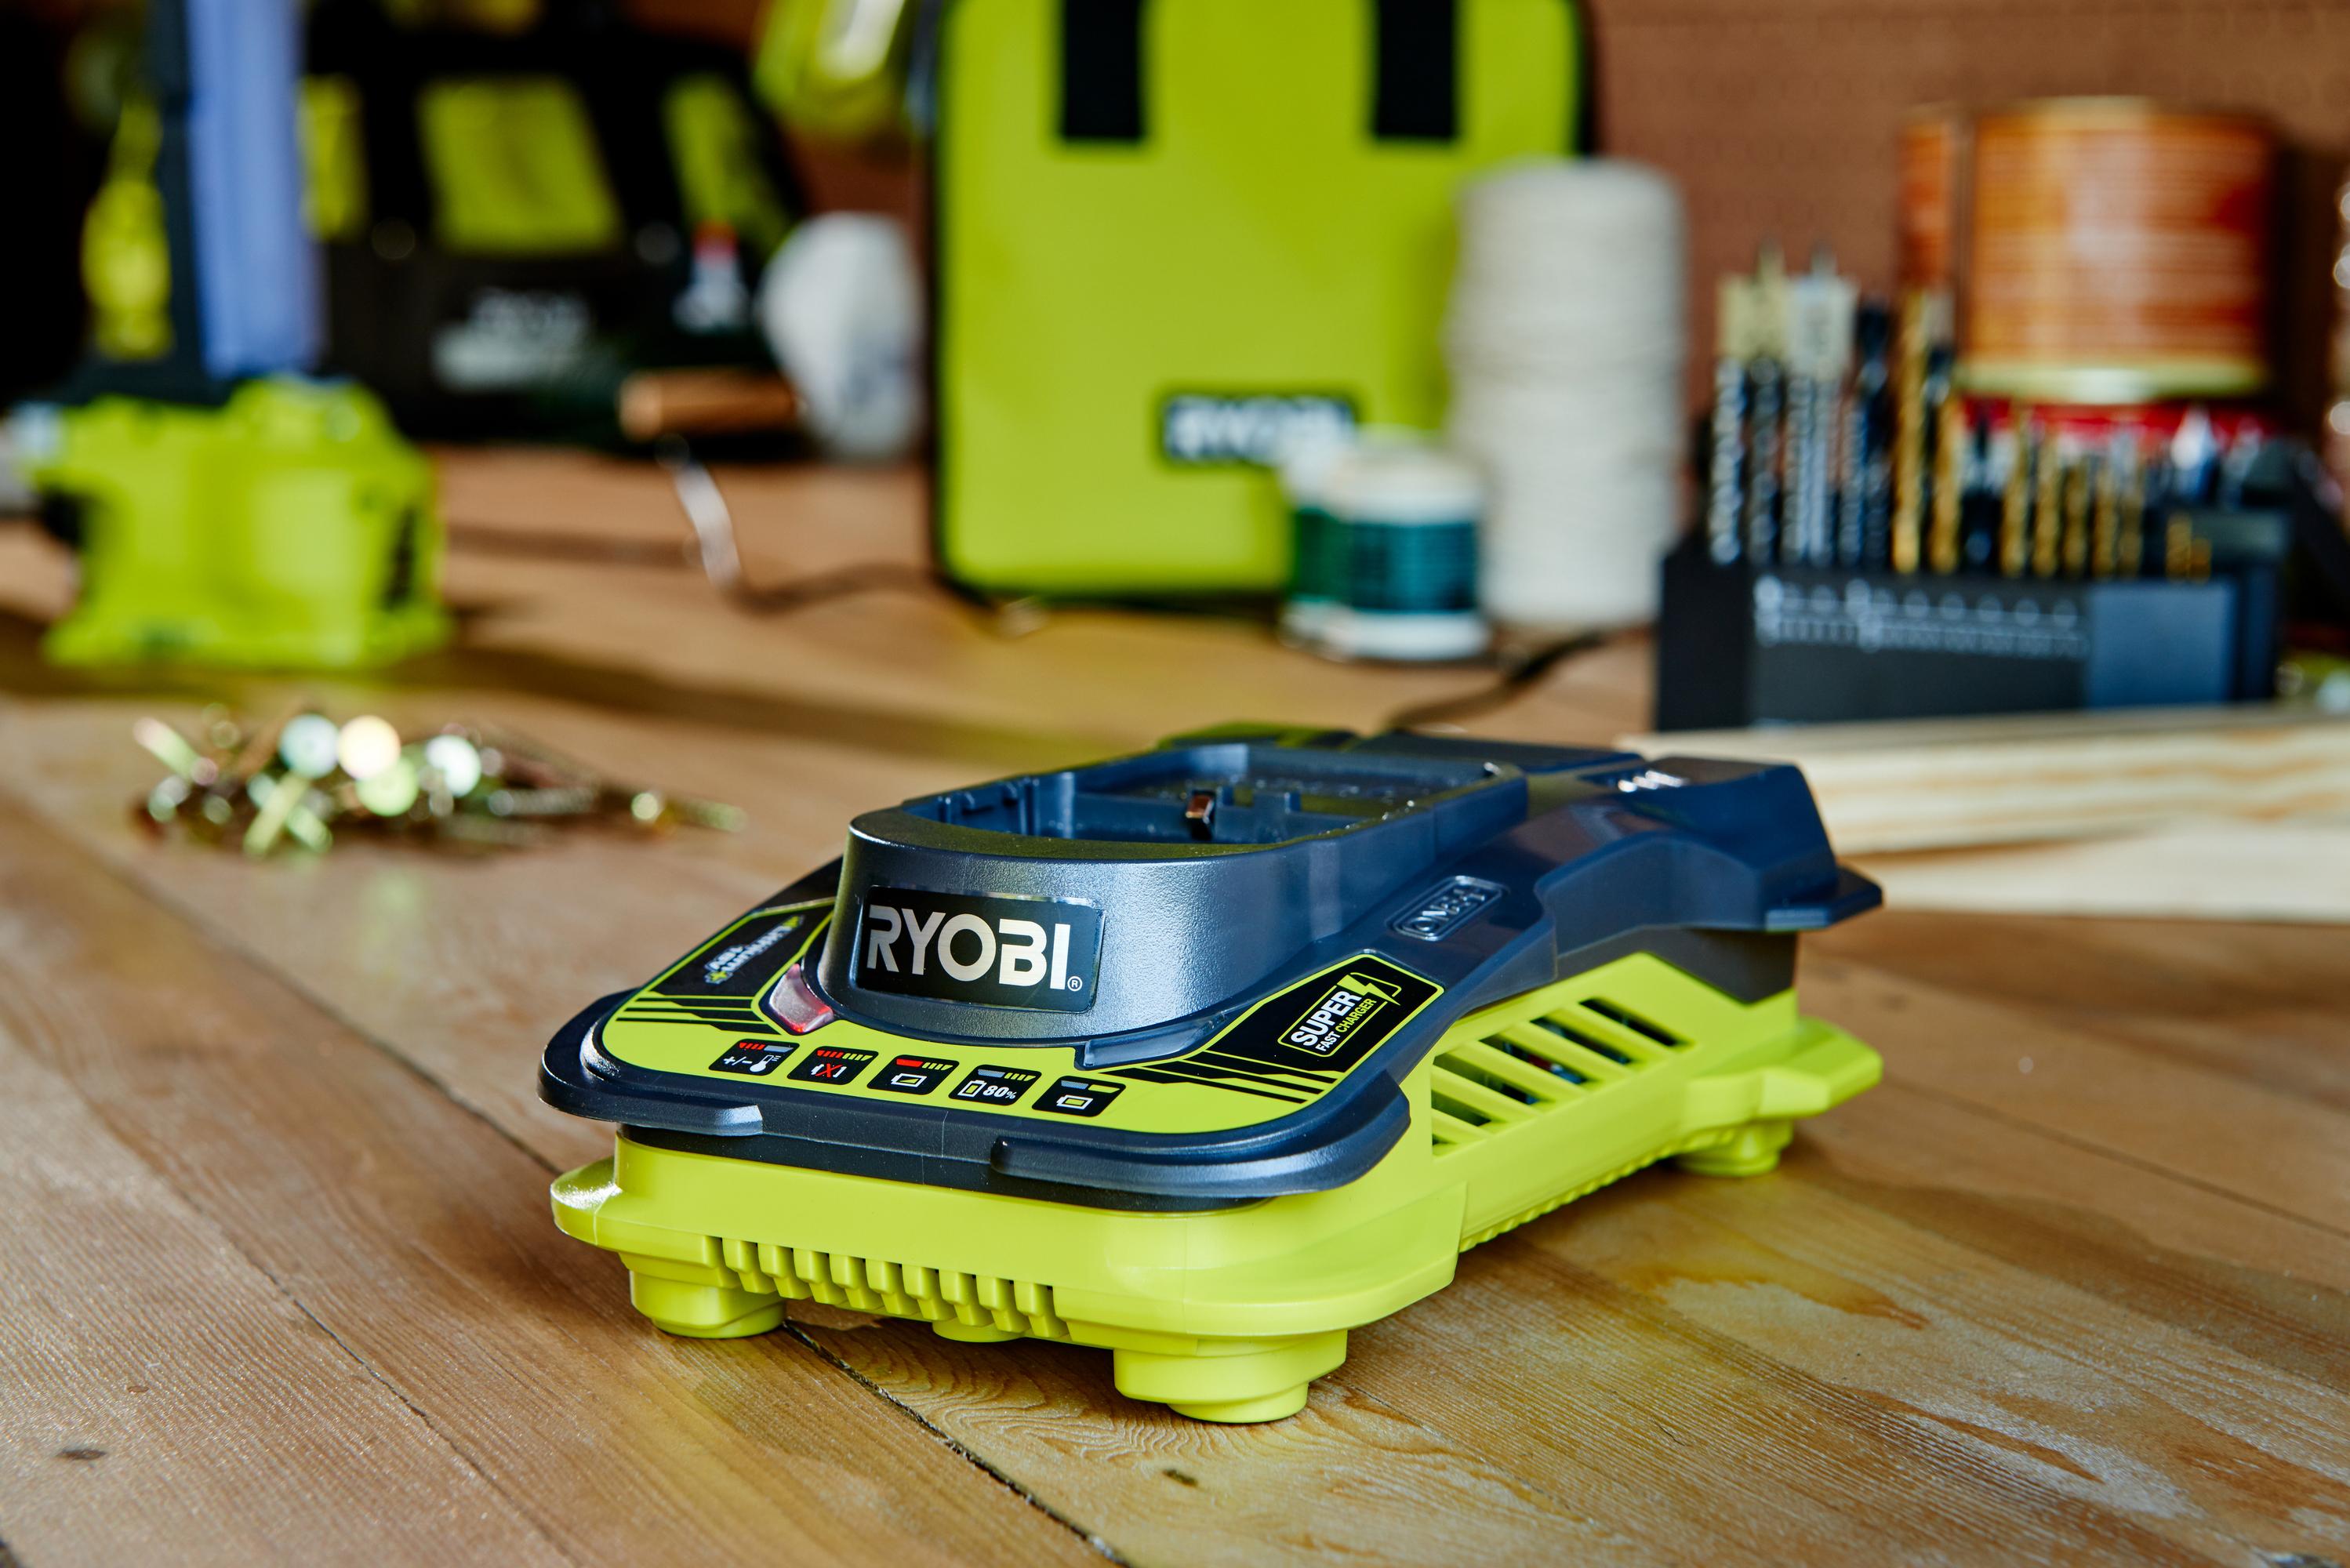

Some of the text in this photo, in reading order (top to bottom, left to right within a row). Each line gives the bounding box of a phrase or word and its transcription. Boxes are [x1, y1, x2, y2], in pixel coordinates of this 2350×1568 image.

[1170, 396, 1350, 461] RYO
[866, 904, 1071, 990] RYOBI
[1291, 990, 1362, 1047] SUPER
[1315, 997, 1377, 1051] FAST CHARGER
[982, 1085, 1017, 1099] 80%
